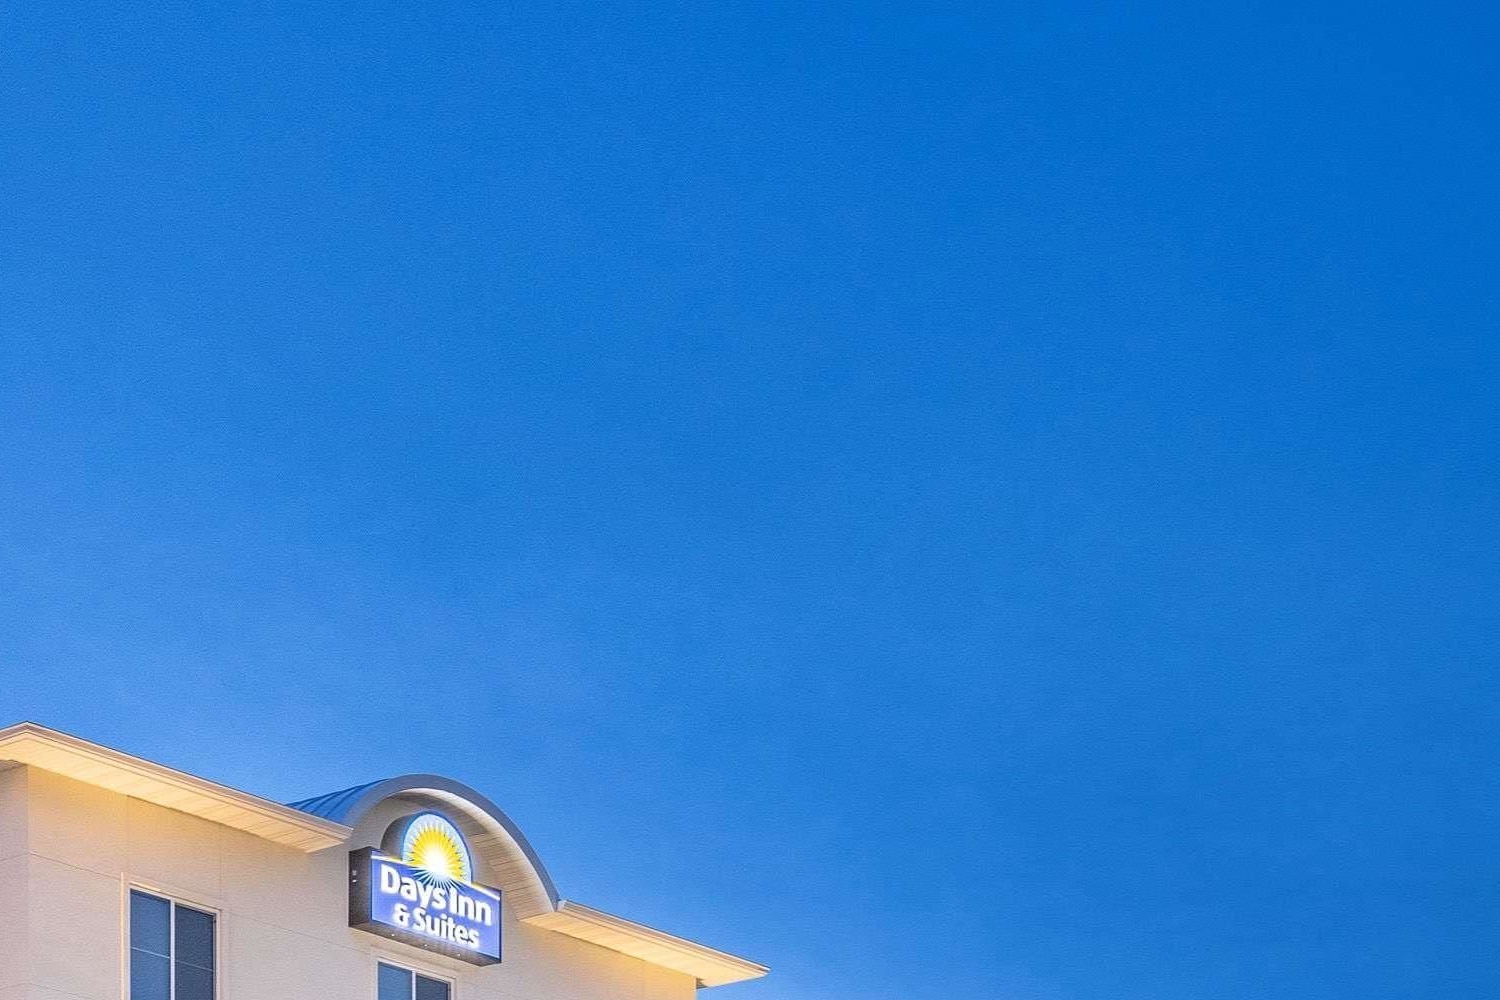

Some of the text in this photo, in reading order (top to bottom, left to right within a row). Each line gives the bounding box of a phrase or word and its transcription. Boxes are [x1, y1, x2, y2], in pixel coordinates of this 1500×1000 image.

[381, 864, 492, 926] Days Inn
[393, 902, 480, 948] & Suites
